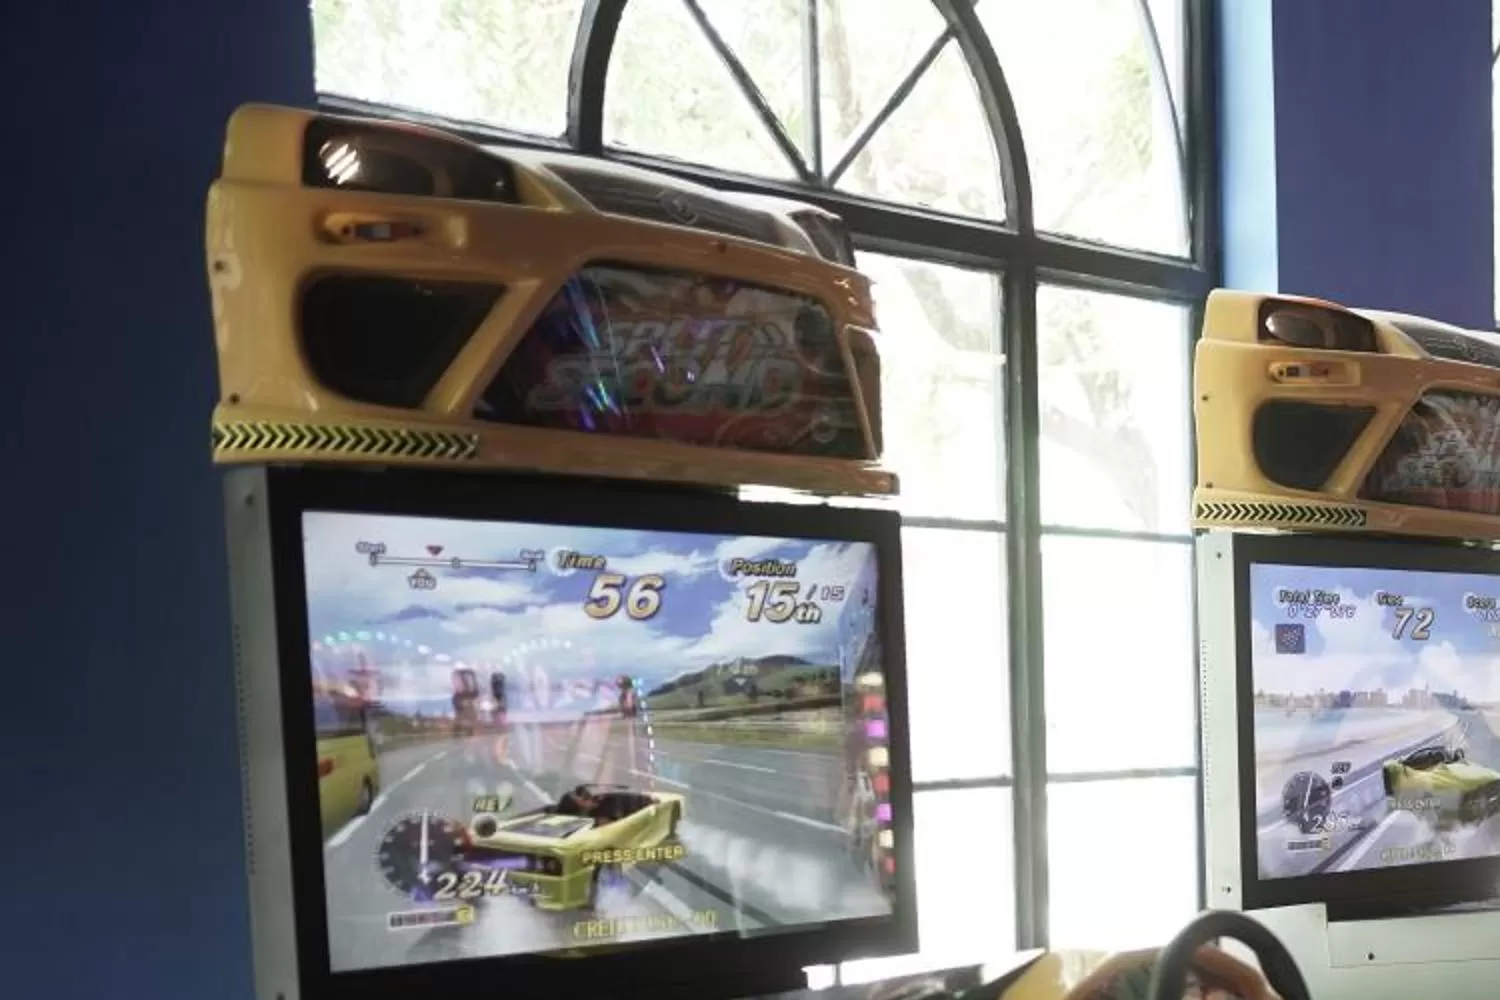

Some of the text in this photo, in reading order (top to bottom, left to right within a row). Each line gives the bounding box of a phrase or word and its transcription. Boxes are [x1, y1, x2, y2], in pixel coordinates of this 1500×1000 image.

[557, 550, 606, 570] Time
[729, 558, 798, 577] Position
[583, 573, 667, 620] 56
[1392, 608, 1435, 640] 72
[581, 844, 685, 865] PRESS ENTER
[435, 869, 508, 900] 224
